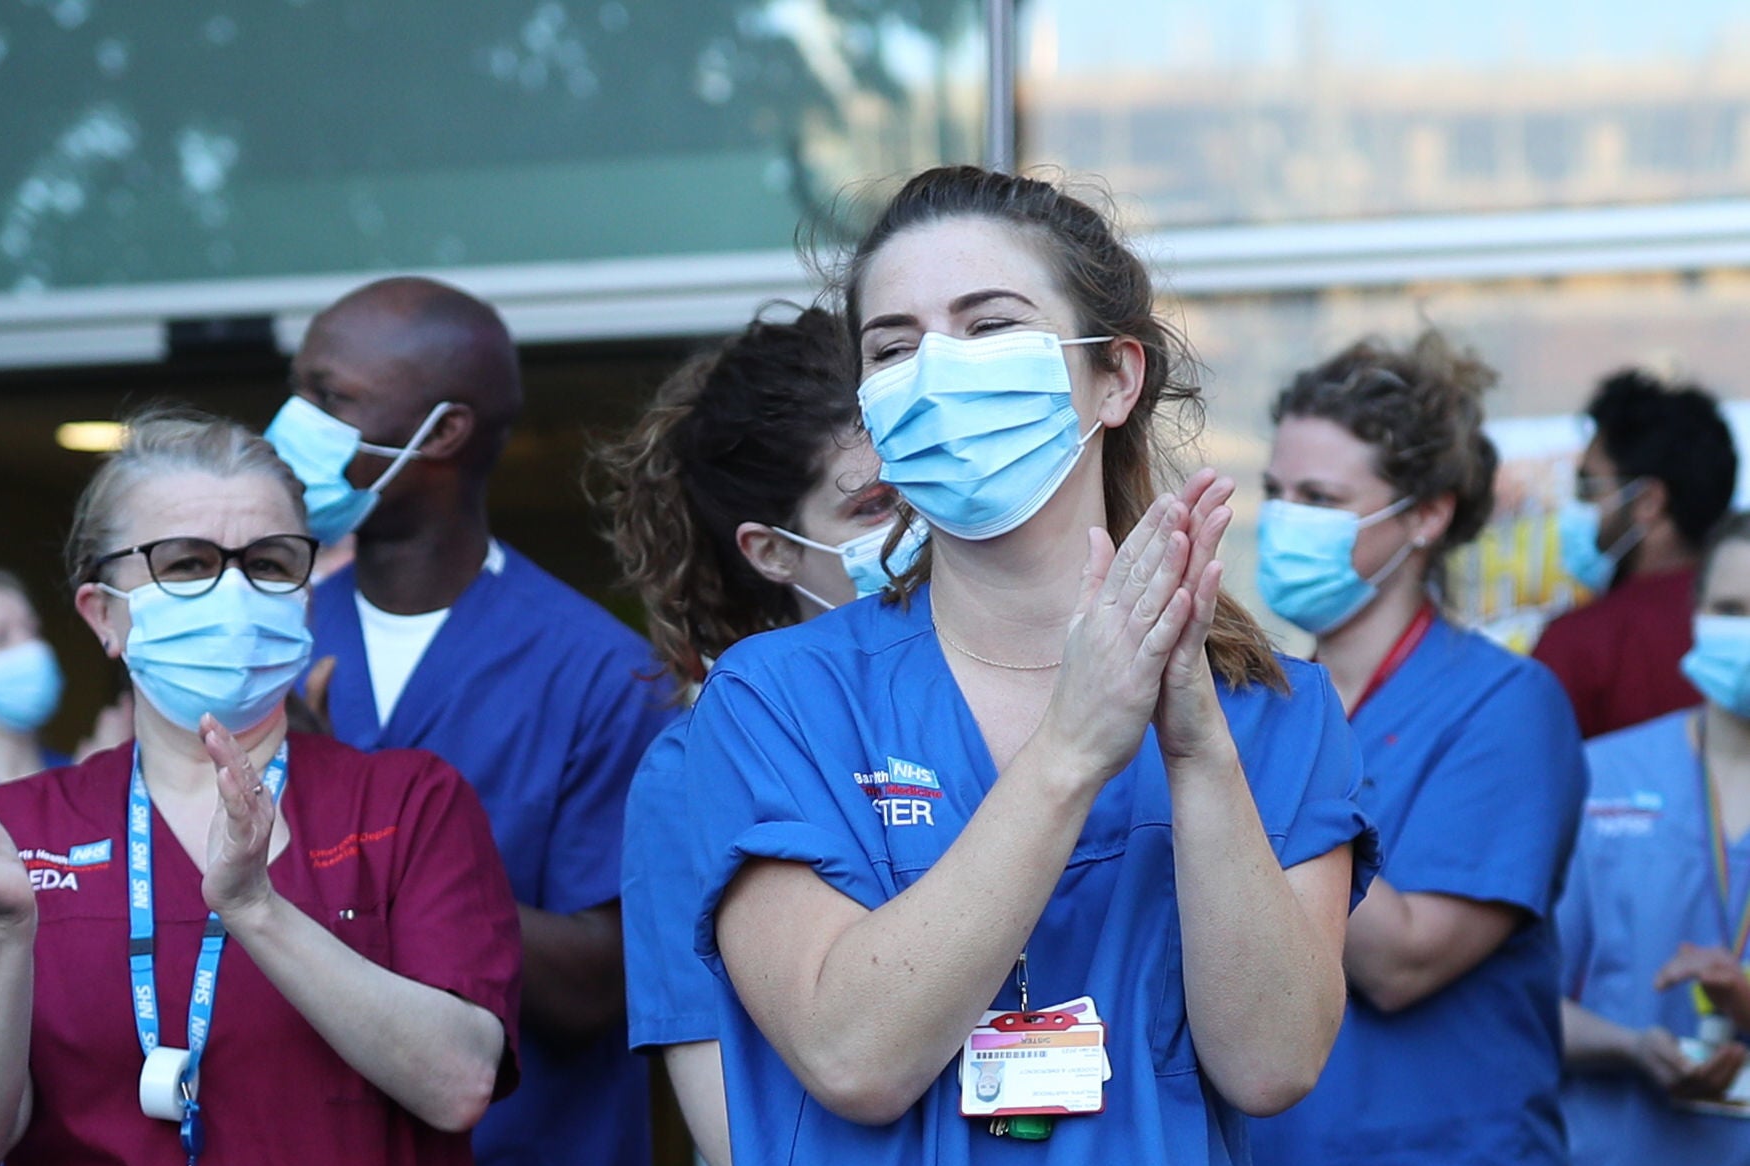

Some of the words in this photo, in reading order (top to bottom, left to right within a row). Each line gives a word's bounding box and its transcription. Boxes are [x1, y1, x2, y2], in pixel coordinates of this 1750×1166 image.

[893, 762, 933, 783] NHS
[131, 803, 149, 836] NHS
[72, 843, 108, 862] NHS
[131, 840, 148, 873] NHS
[132, 878, 149, 911] NHS
[136, 985, 155, 1020] NHS
[194, 968, 214, 1006] NHS
